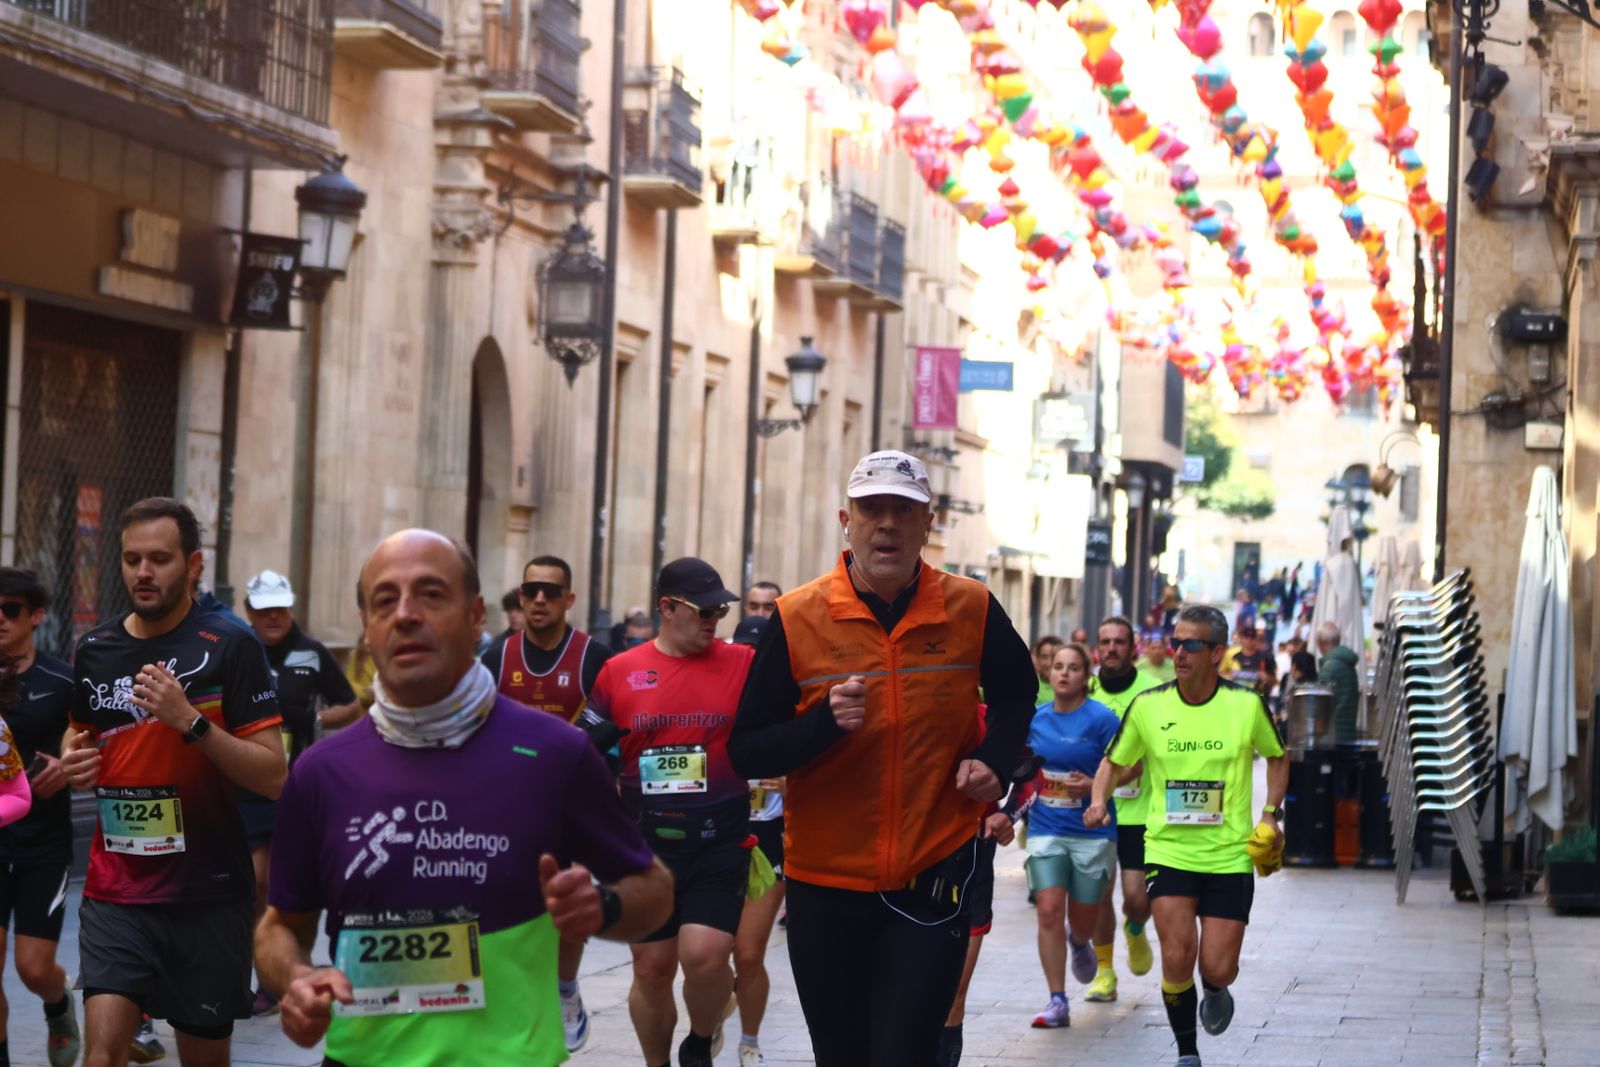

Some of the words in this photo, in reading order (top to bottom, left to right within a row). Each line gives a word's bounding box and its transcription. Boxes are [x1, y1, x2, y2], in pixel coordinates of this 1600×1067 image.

[657, 756, 689, 770] 268
[1181, 791, 1209, 804] 173
[112, 802, 164, 822] 1224
[415, 800, 448, 823] C.D.
[415, 826, 510, 858] Abadengo
[413, 855, 488, 885] Running
[408, 909, 435, 921] 2026
[358, 931, 452, 964] 2282
[419, 996, 470, 1008] bedunia
